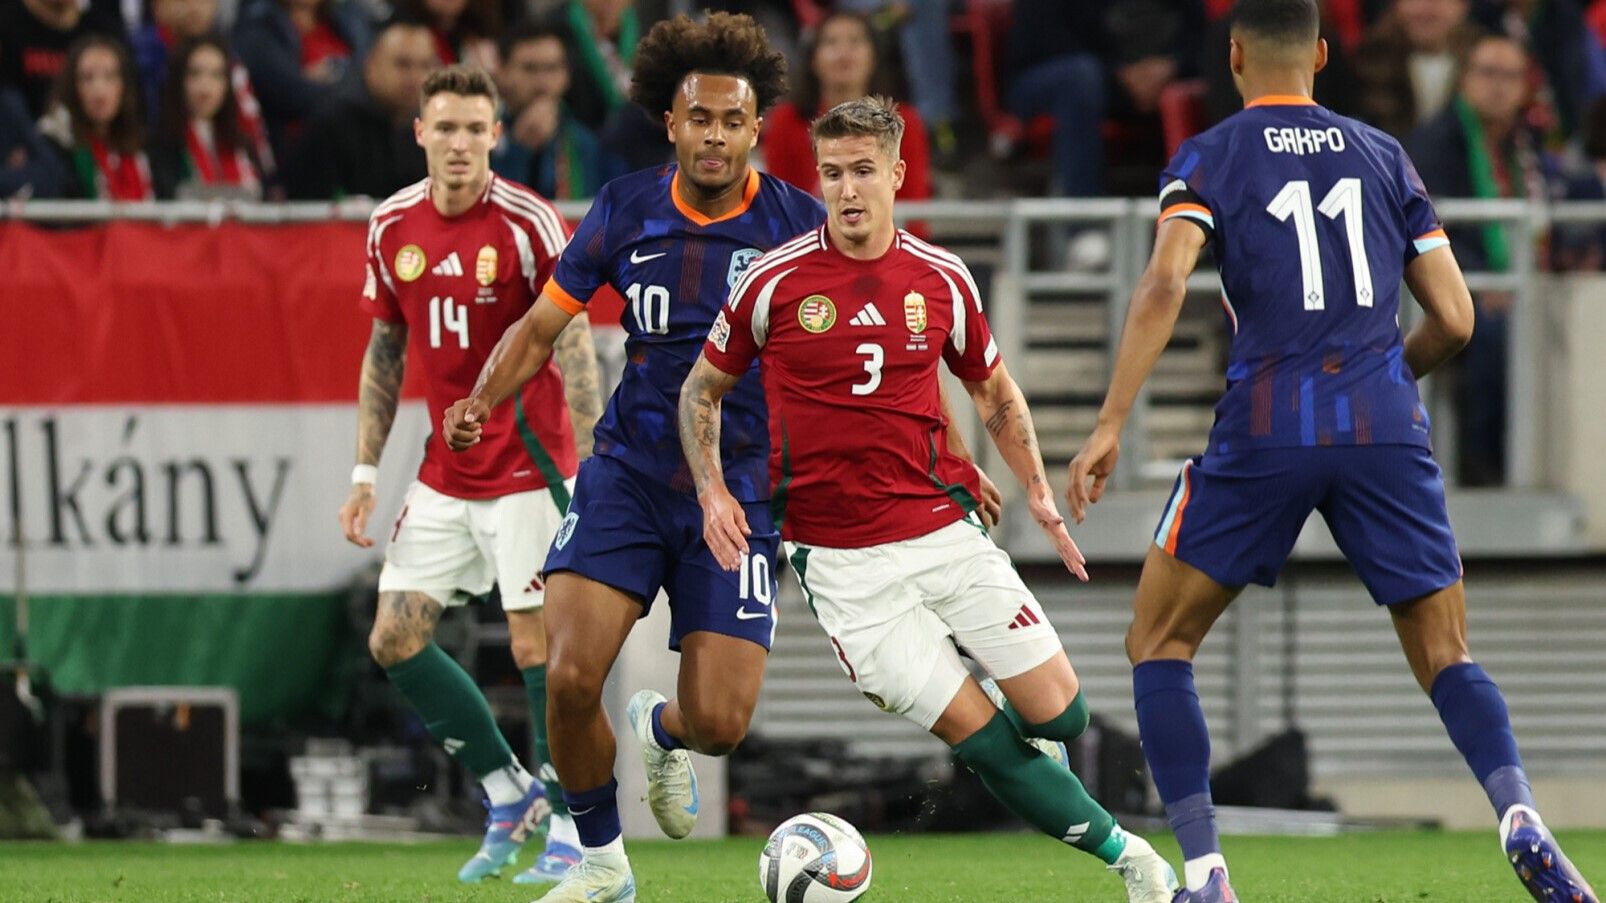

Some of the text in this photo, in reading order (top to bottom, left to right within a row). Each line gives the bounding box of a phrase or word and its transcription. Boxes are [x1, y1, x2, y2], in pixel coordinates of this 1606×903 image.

[1263, 126, 1346, 155] GAKPO
[1266, 177, 1374, 311] 11
[428, 295, 470, 350] 14
[625, 282, 670, 335] 10
[851, 343, 884, 396] 3
[4, 415, 292, 583] lkány
[739, 550, 771, 606] 10
